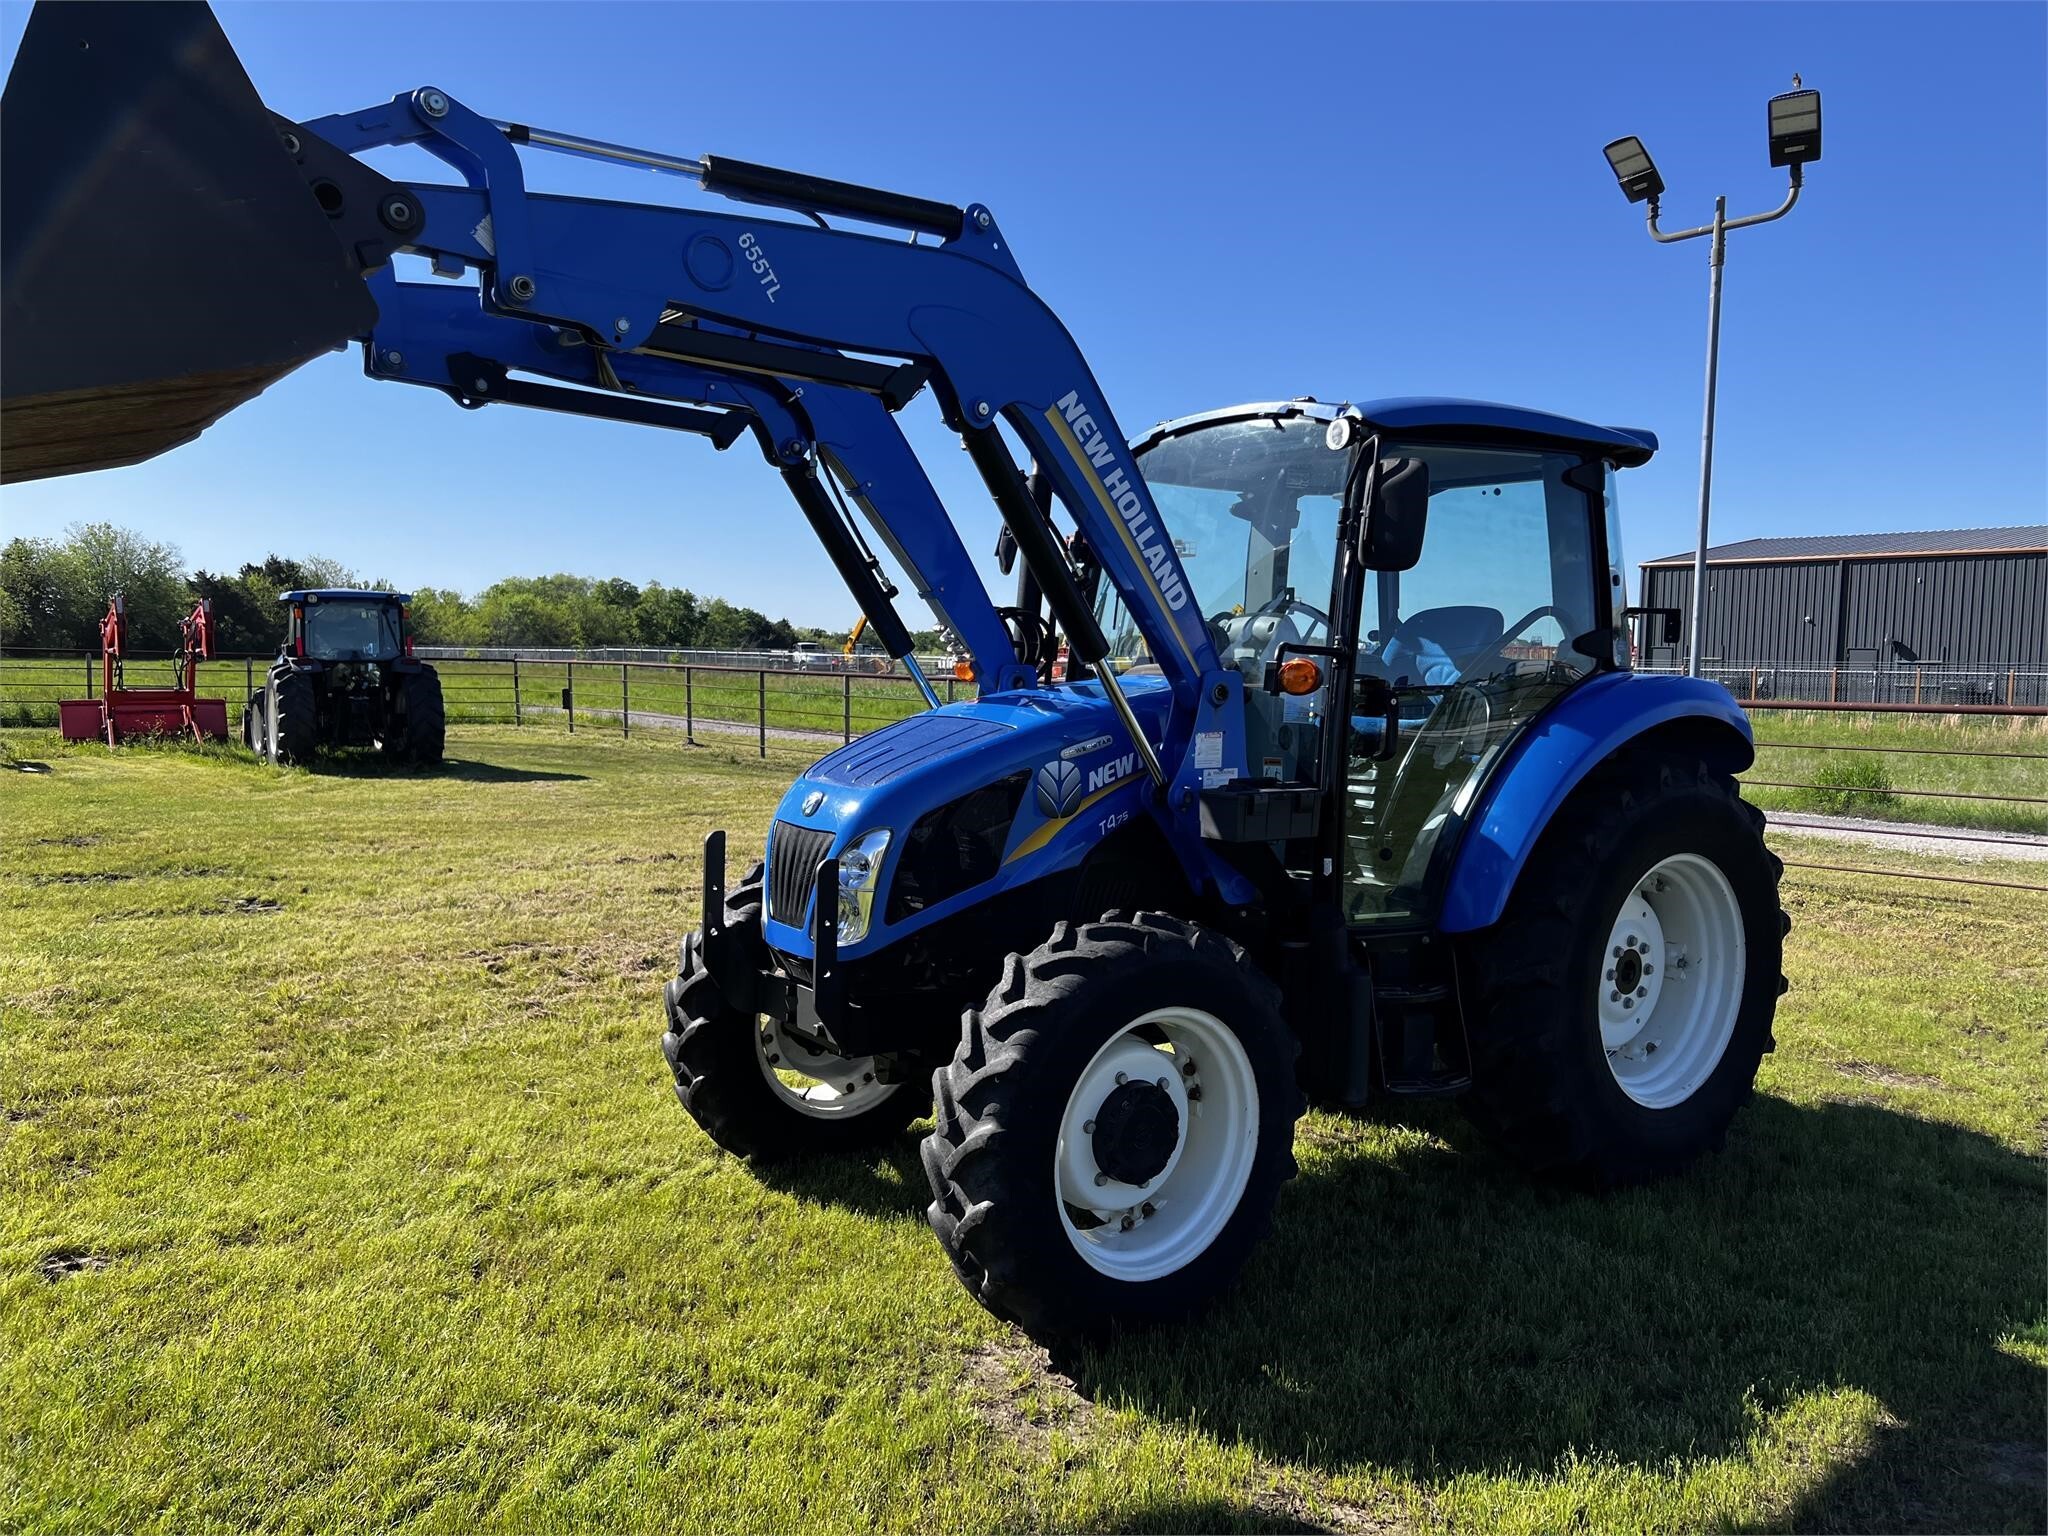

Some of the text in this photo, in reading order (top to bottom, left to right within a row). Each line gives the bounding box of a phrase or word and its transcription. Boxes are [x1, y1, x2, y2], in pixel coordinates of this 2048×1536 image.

[739, 233, 780, 303] 655TL
[1057, 390, 1187, 611] NEW HOLLAND
[1089, 753, 1134, 792] NEW
